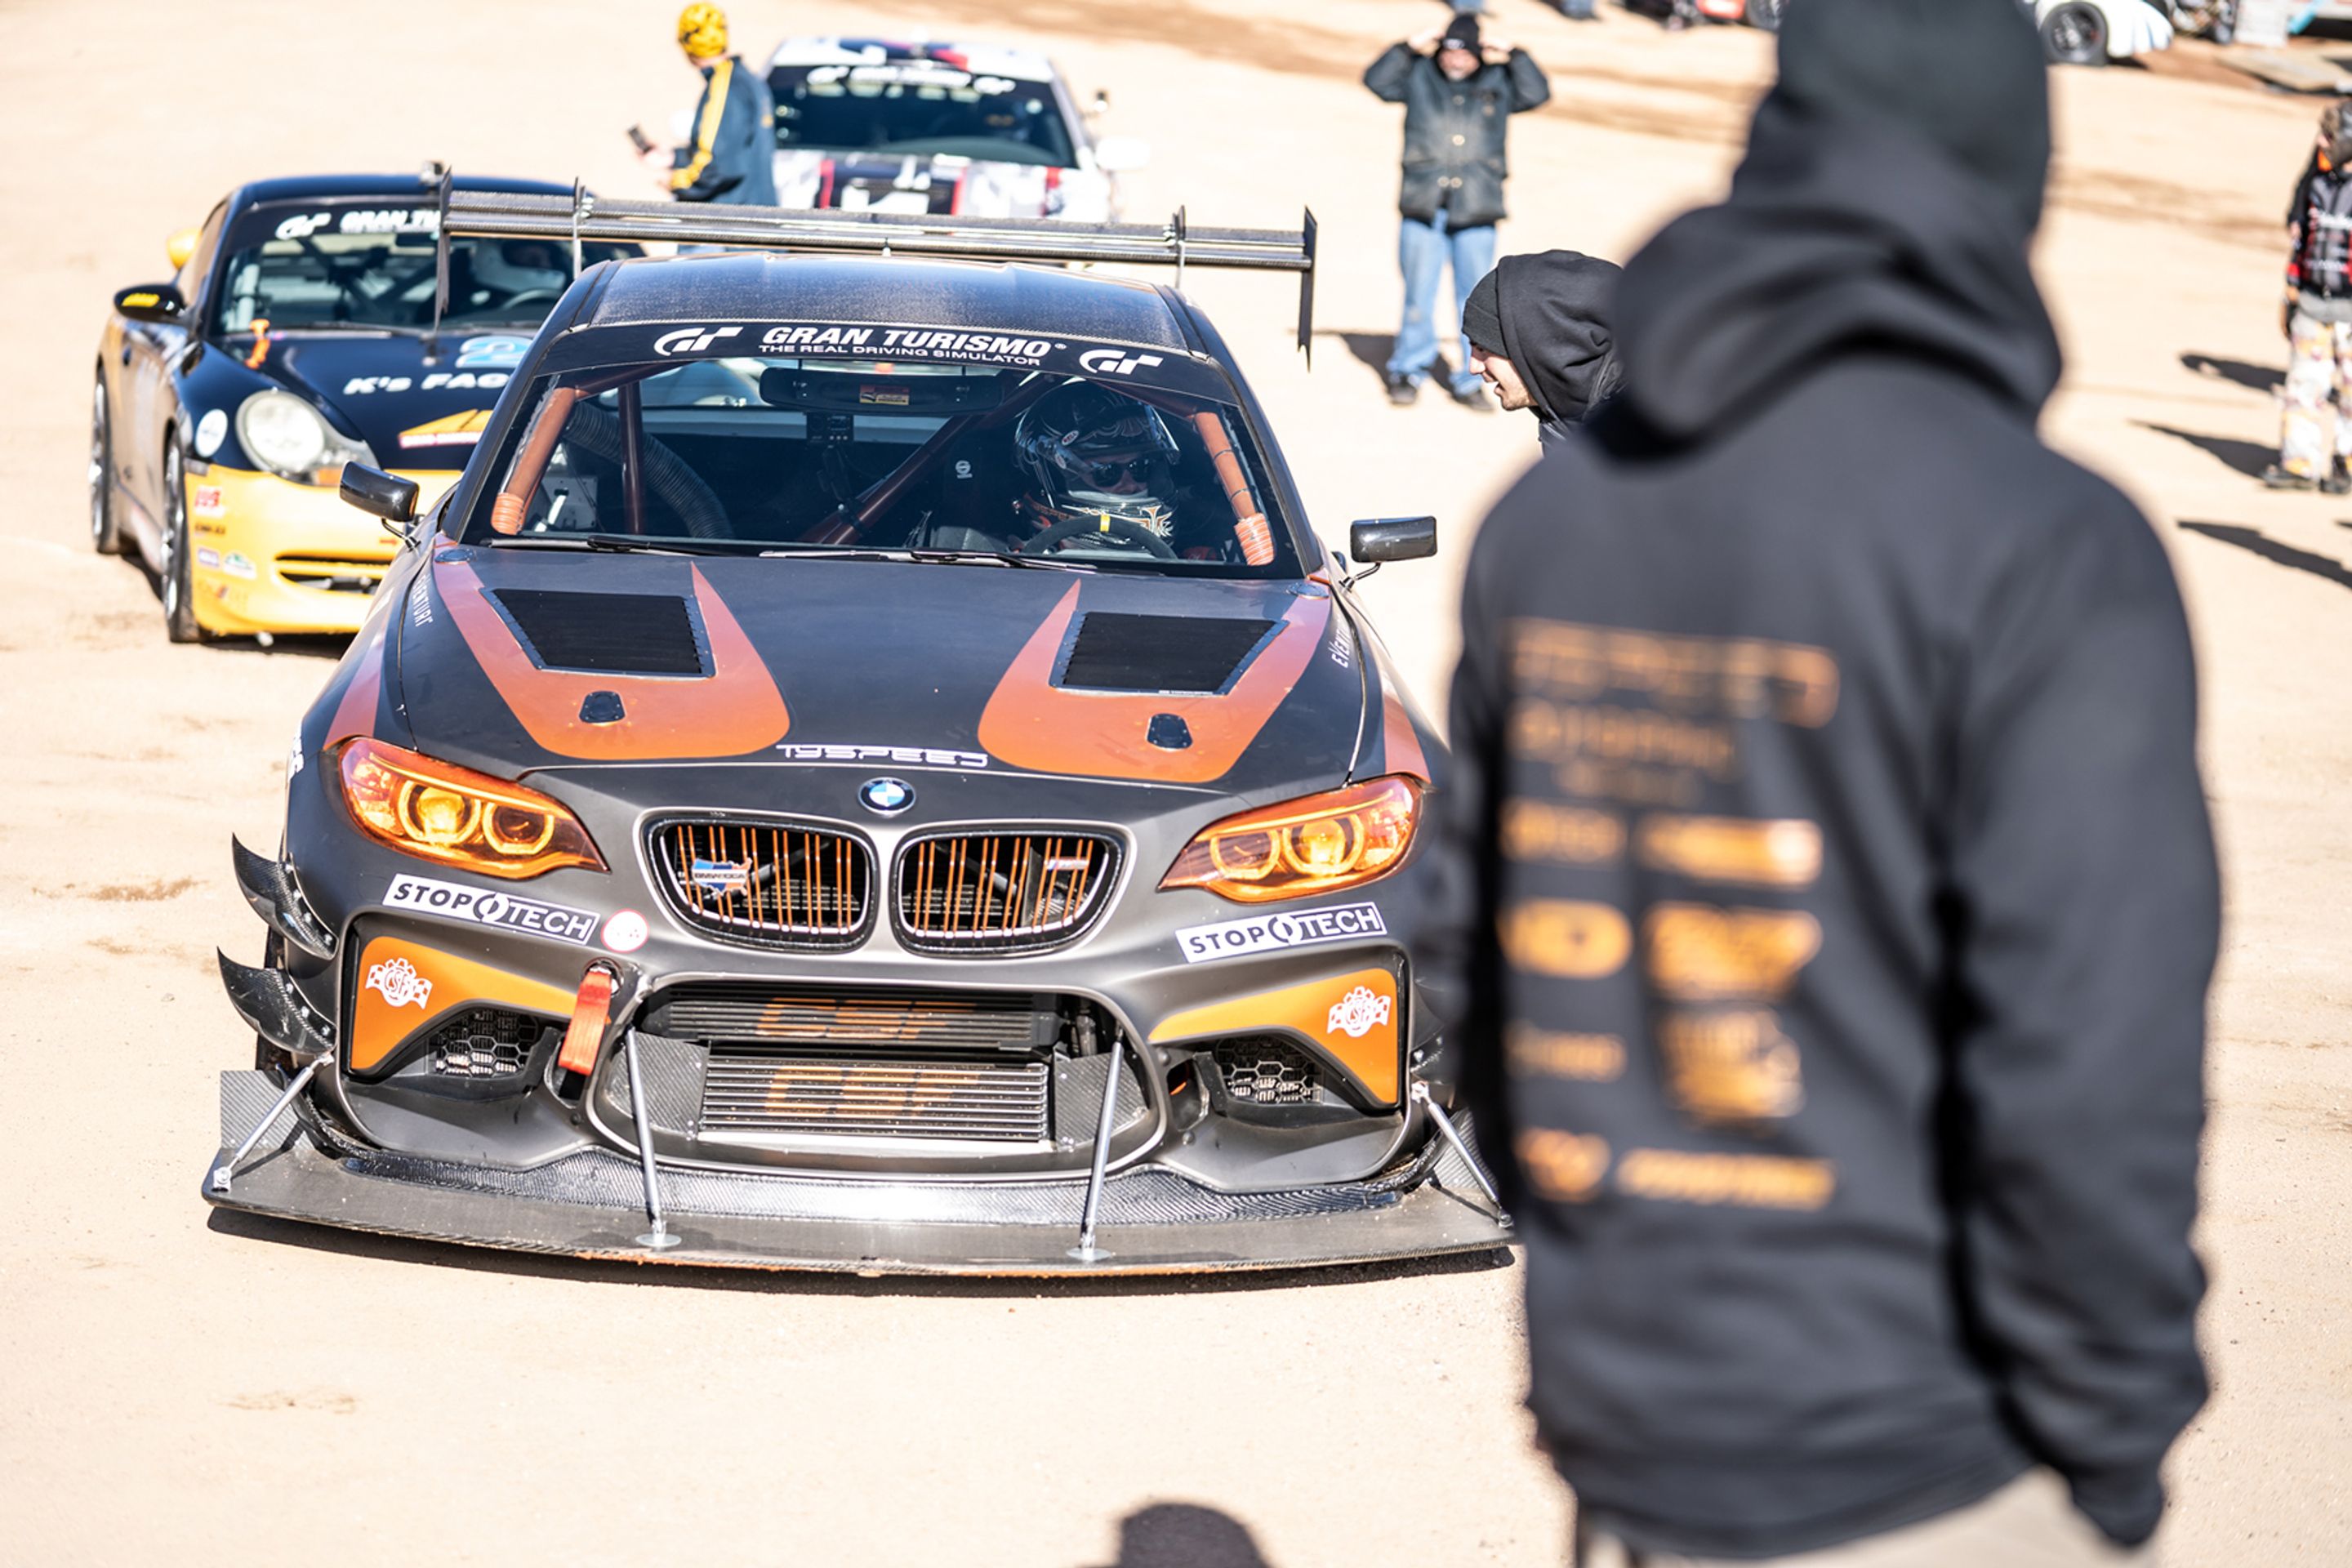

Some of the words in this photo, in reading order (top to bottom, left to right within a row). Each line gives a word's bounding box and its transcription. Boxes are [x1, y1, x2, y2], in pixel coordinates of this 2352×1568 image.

[759, 345, 795, 353] THE
[800, 345, 849, 354] REAL
[858, 346, 929, 357] DRIVING
[933, 350, 1040, 366] SIMULATOR
[762, 327, 874, 346] GRAN
[881, 329, 1052, 358] TURISMO
